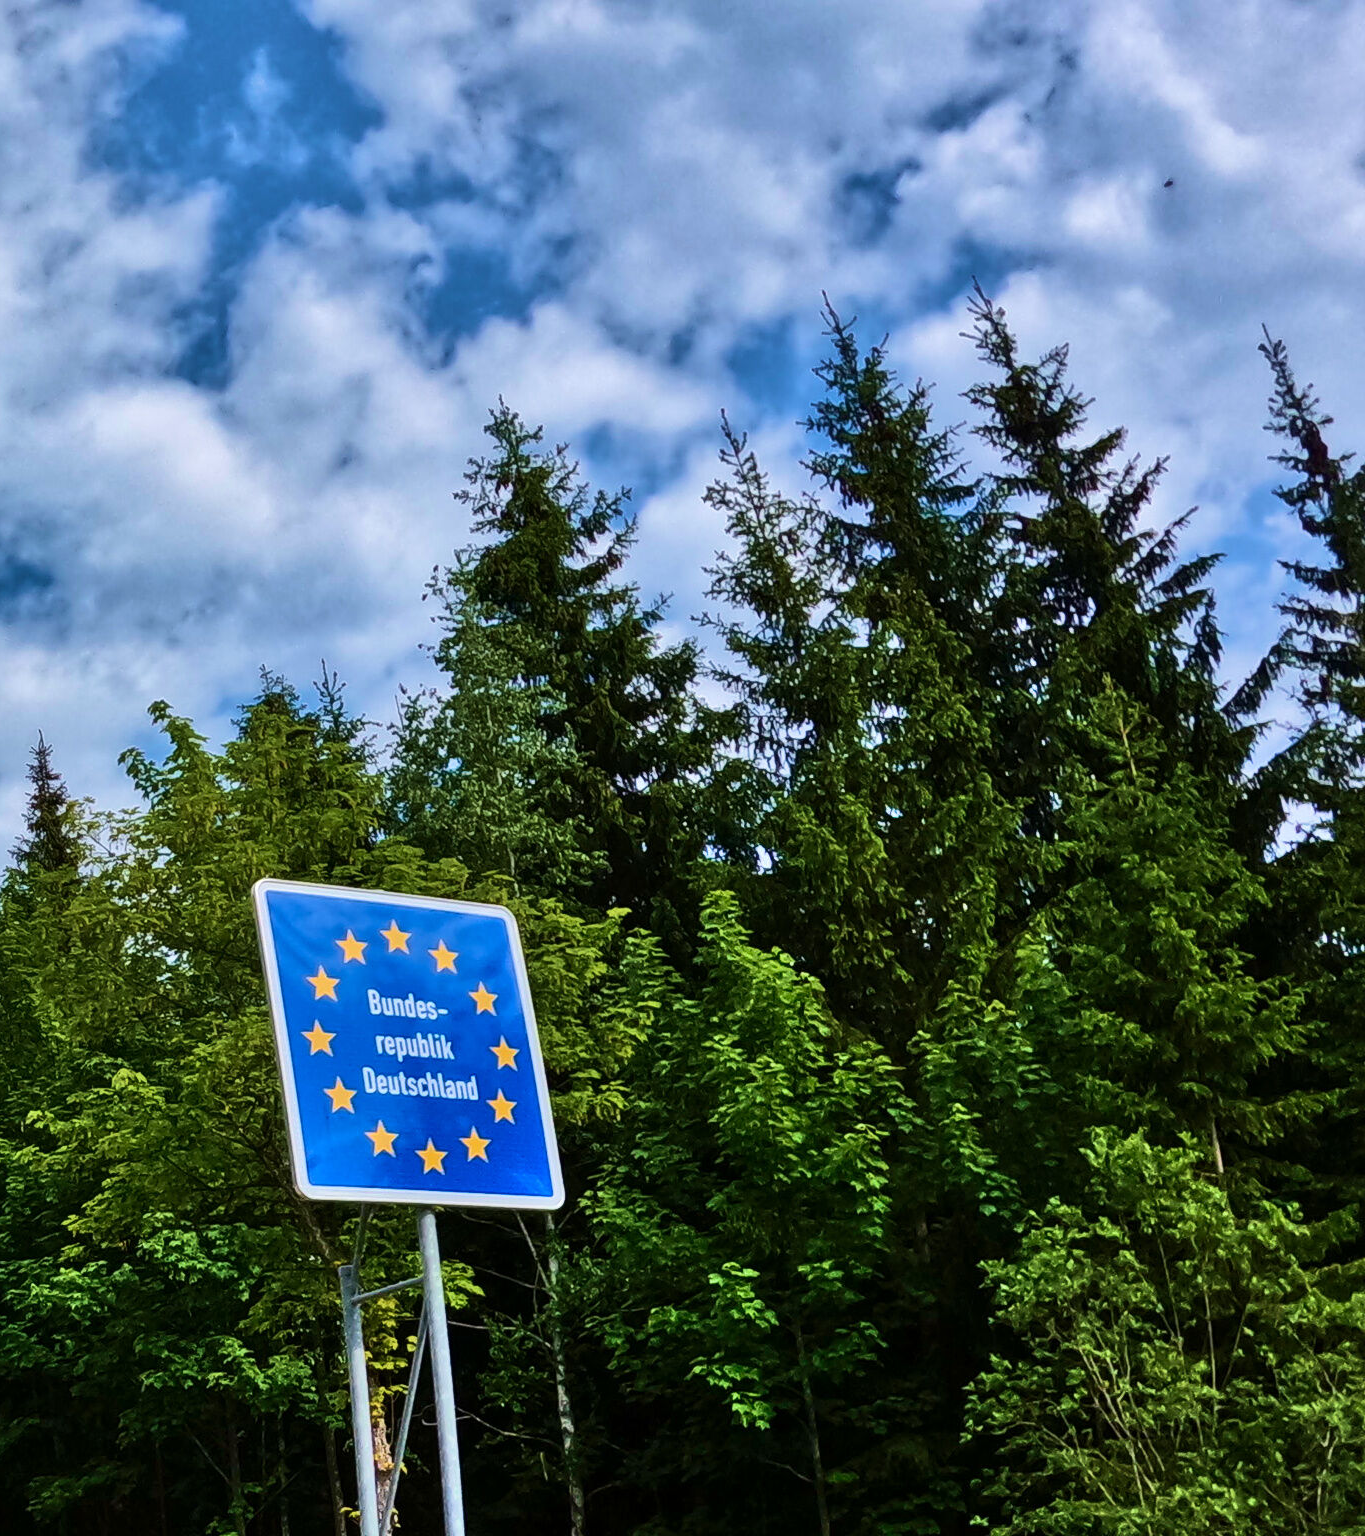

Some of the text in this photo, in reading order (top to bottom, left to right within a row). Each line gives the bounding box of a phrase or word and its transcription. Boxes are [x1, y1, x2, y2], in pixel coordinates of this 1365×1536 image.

[367, 989, 448, 1020] Bundes-
[375, 1032, 455, 1063] republik
[362, 1067, 479, 1100] Deutschland
